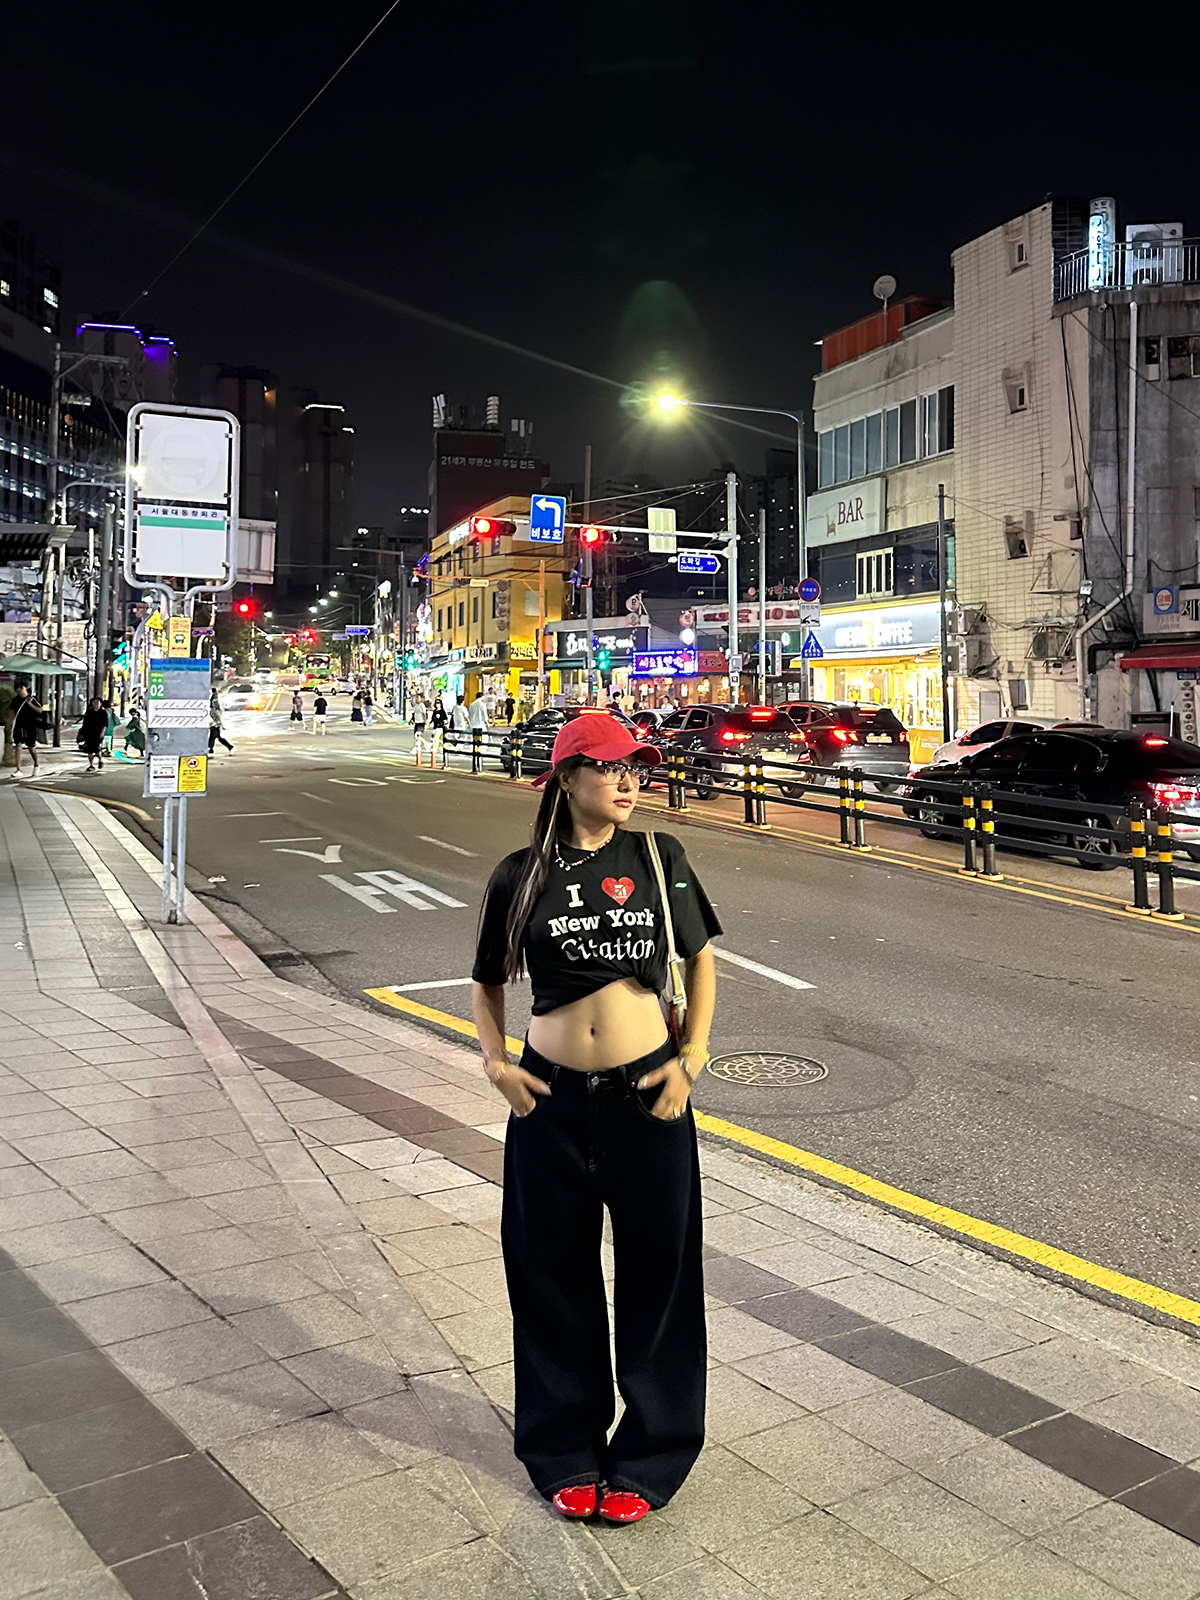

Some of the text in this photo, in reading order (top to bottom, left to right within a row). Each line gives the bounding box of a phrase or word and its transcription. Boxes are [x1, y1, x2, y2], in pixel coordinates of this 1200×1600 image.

[440, 456, 466, 466] 21세기
[468, 457, 492, 467] 부동산
[837, 497, 864, 525] BAR
[531, 527, 562, 540] 비보호
[150, 684, 164, 697] 02
[565, 883, 585, 908] I
[548, 908, 655, 937] New York
[561, 931, 656, 961] Citation
